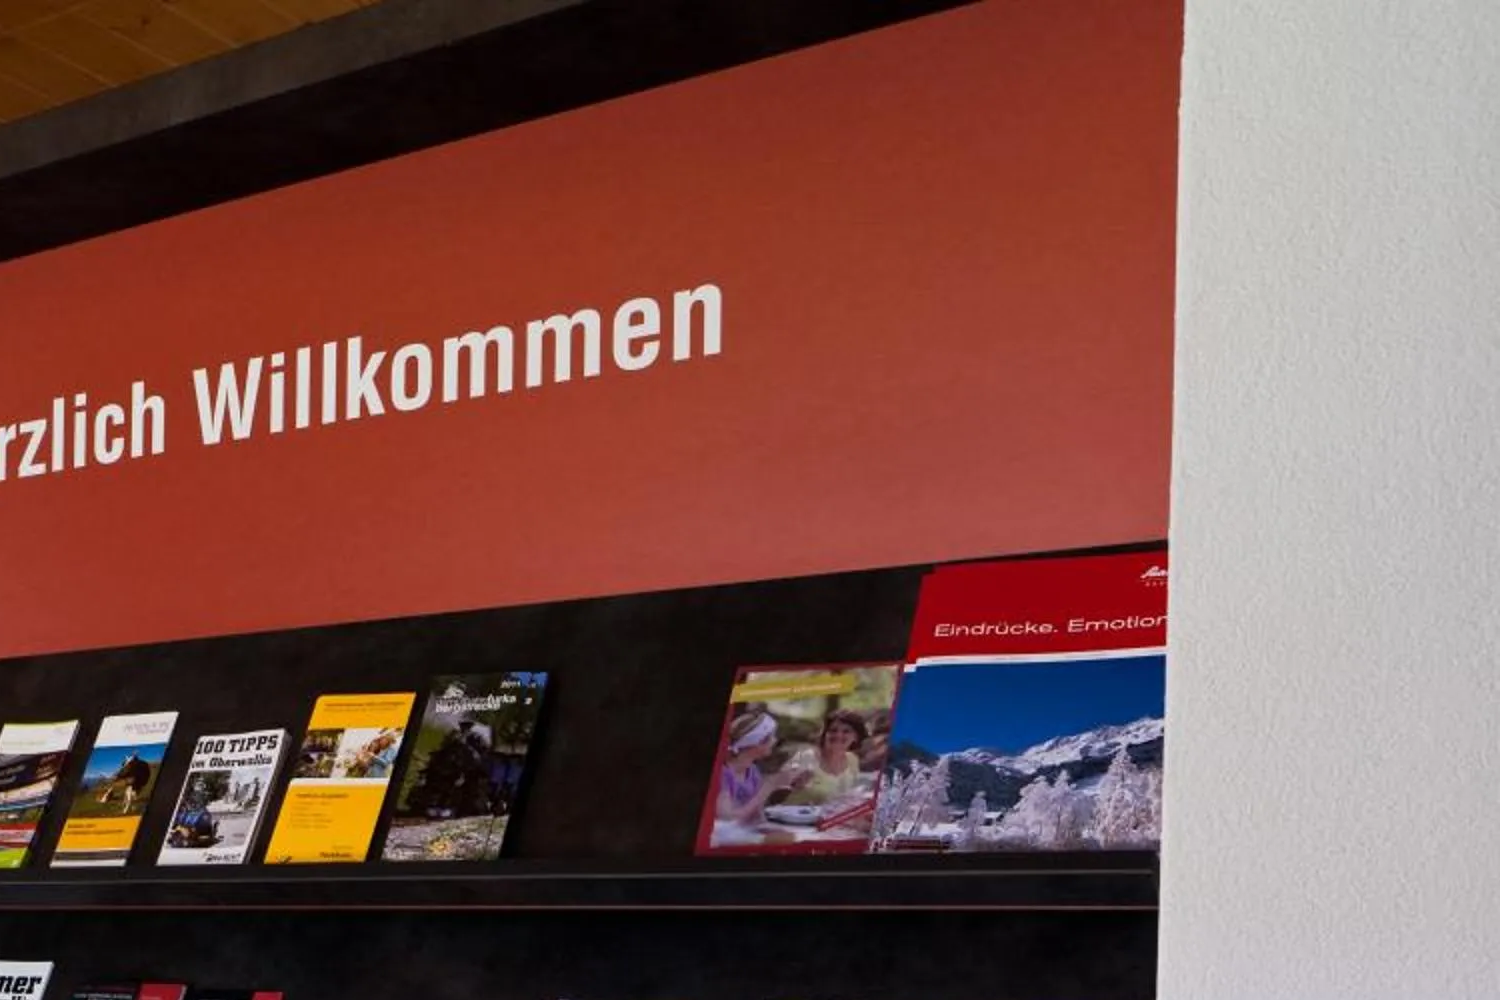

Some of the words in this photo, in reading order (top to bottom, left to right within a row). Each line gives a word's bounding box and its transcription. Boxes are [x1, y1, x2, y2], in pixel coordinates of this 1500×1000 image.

[193, 284, 722, 445] Willkommen
[933, 621, 1060, 638] Eindrücke.
[196, 740, 225, 755] 100
[229, 734, 278, 753] TIPPS
